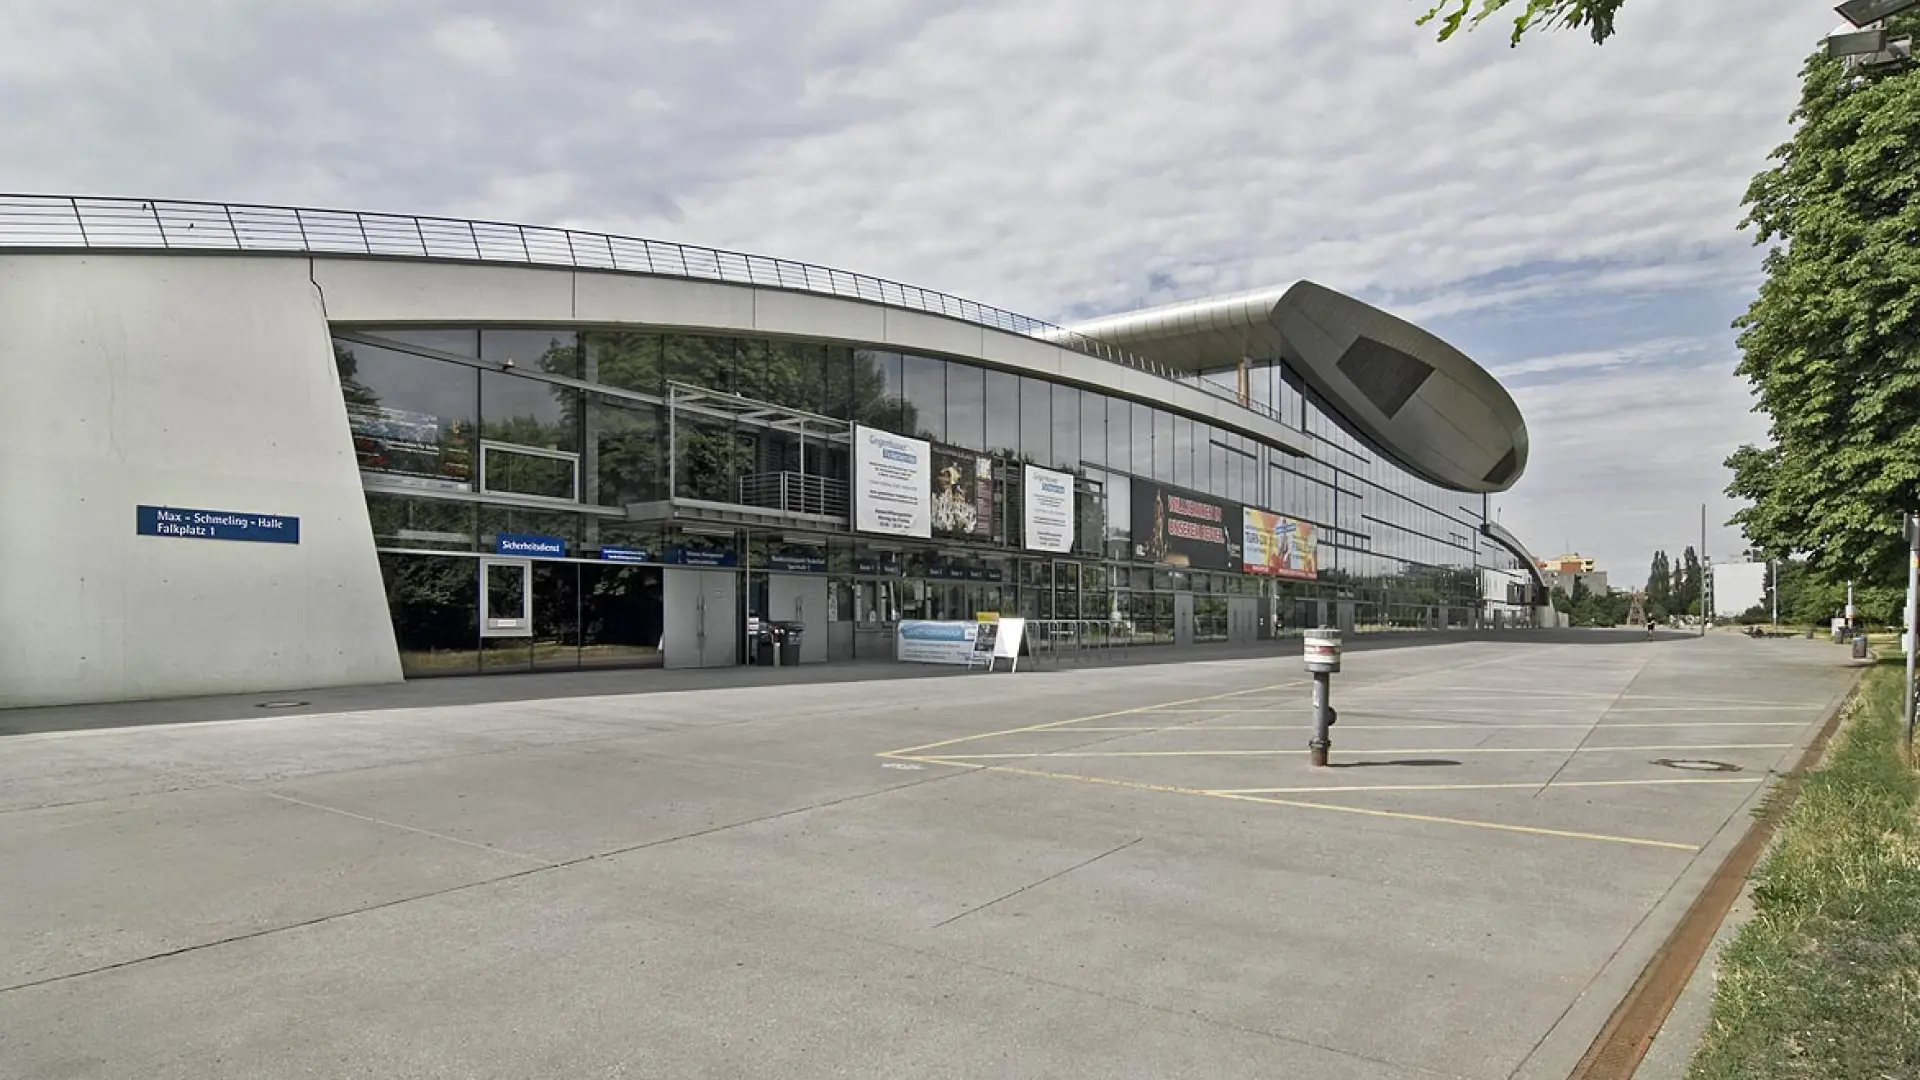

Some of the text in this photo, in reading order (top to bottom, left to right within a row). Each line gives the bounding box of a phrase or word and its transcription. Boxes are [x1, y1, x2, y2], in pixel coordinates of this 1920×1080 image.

[156, 509, 181, 522] Max
[194, 513, 247, 529] Schmeling
[258, 518, 283, 529] Halle
[156, 523, 215, 537] Falkplatz 1
[502, 540, 560, 552] Sicherheitsdienst
